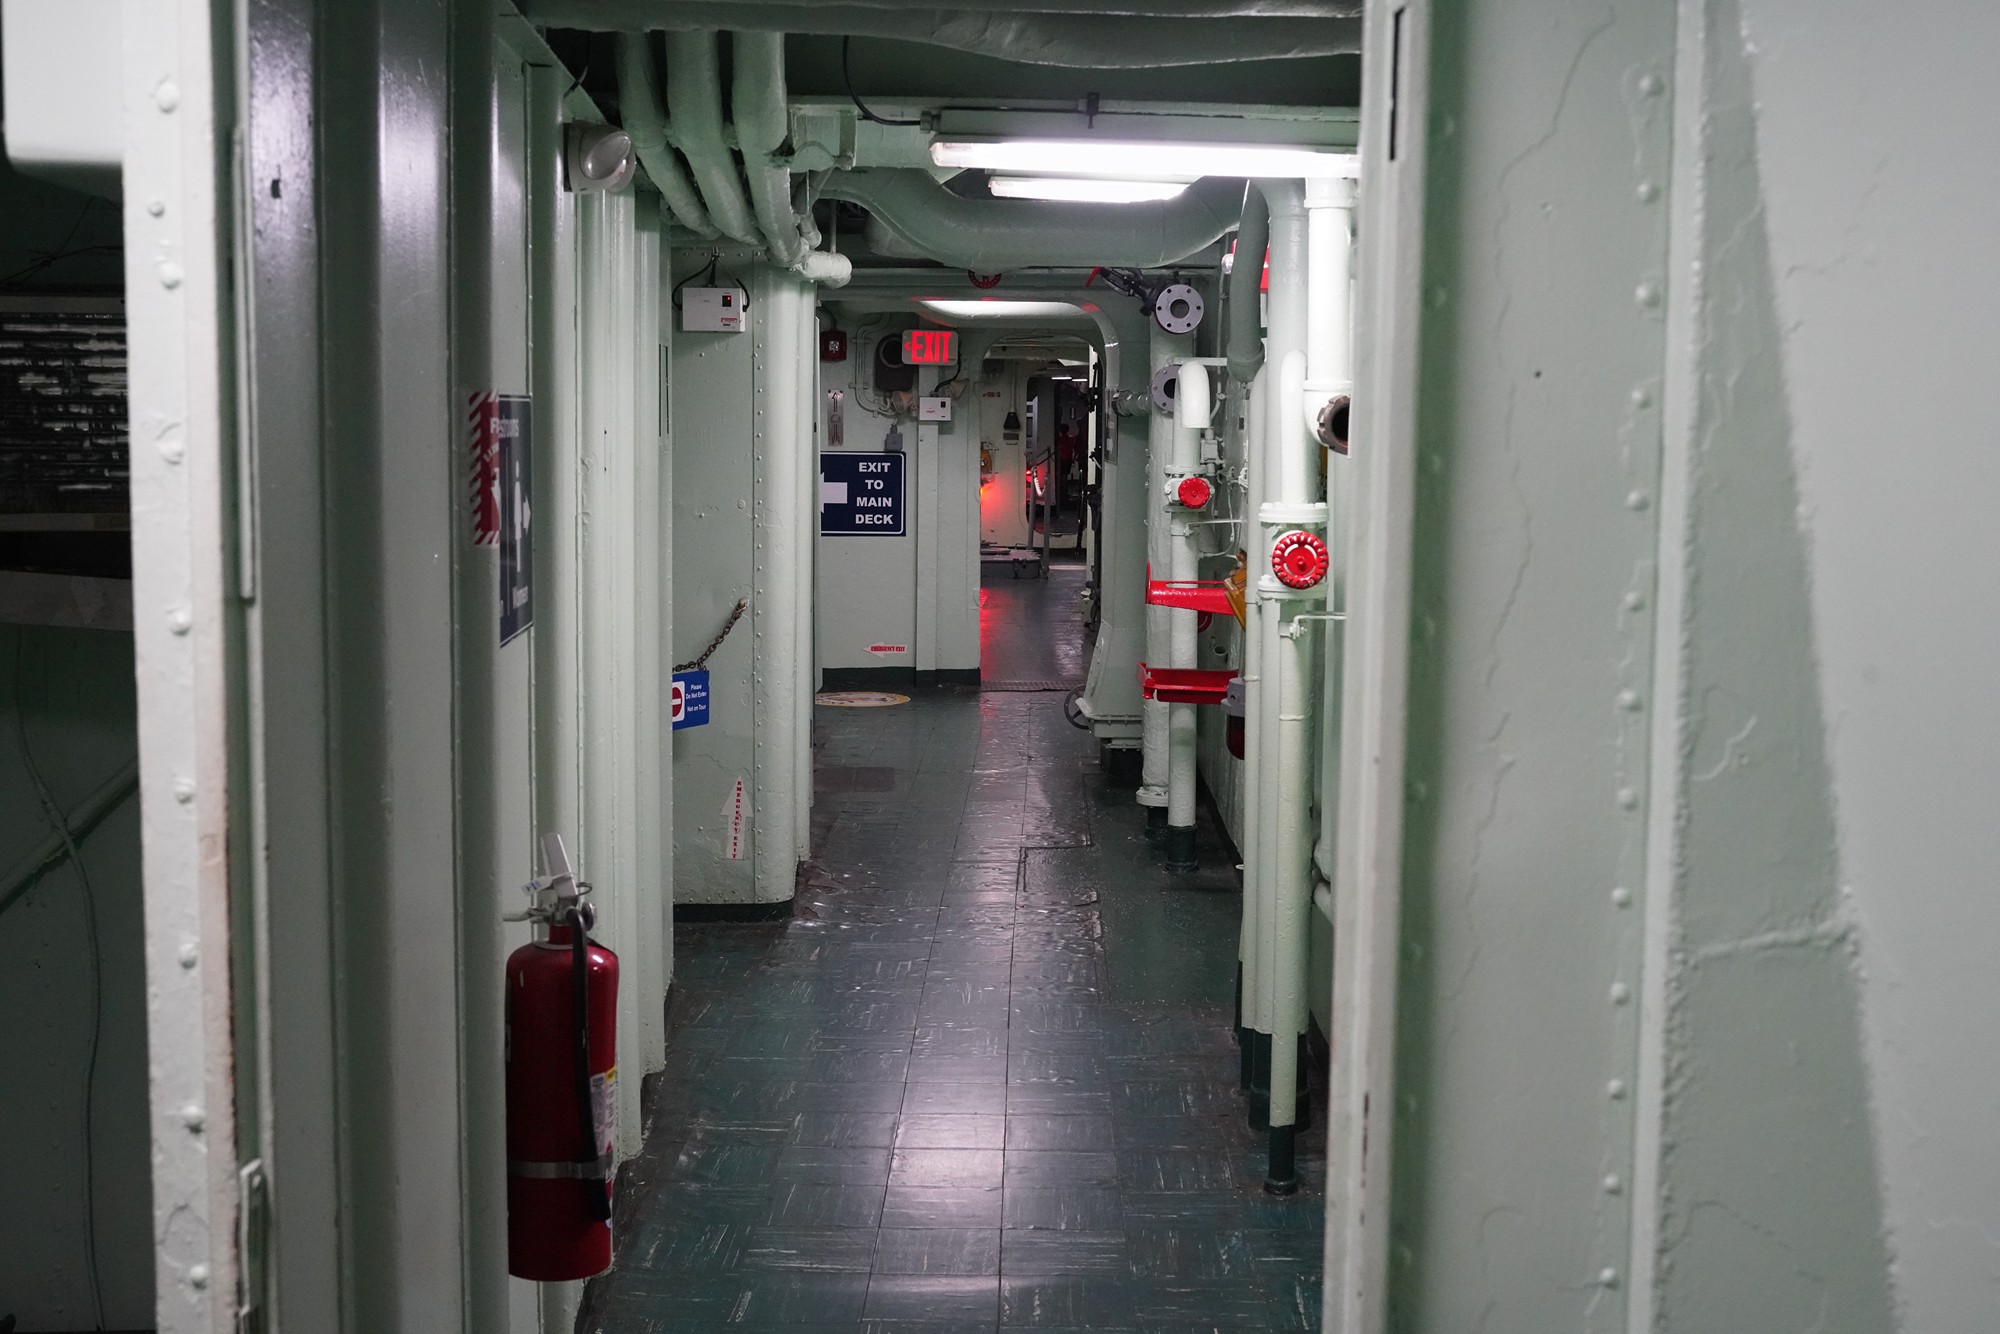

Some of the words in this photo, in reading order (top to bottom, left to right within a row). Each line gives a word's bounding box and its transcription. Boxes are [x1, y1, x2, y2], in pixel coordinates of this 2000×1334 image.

[911, 331, 952, 363] EXIT
[858, 462, 891, 473] EXIT
[864, 479, 884, 490] TO
[856, 497, 892, 507] MAIN
[855, 514, 893, 525] DECK
[733, 781, 742, 834] EMERGENCY
